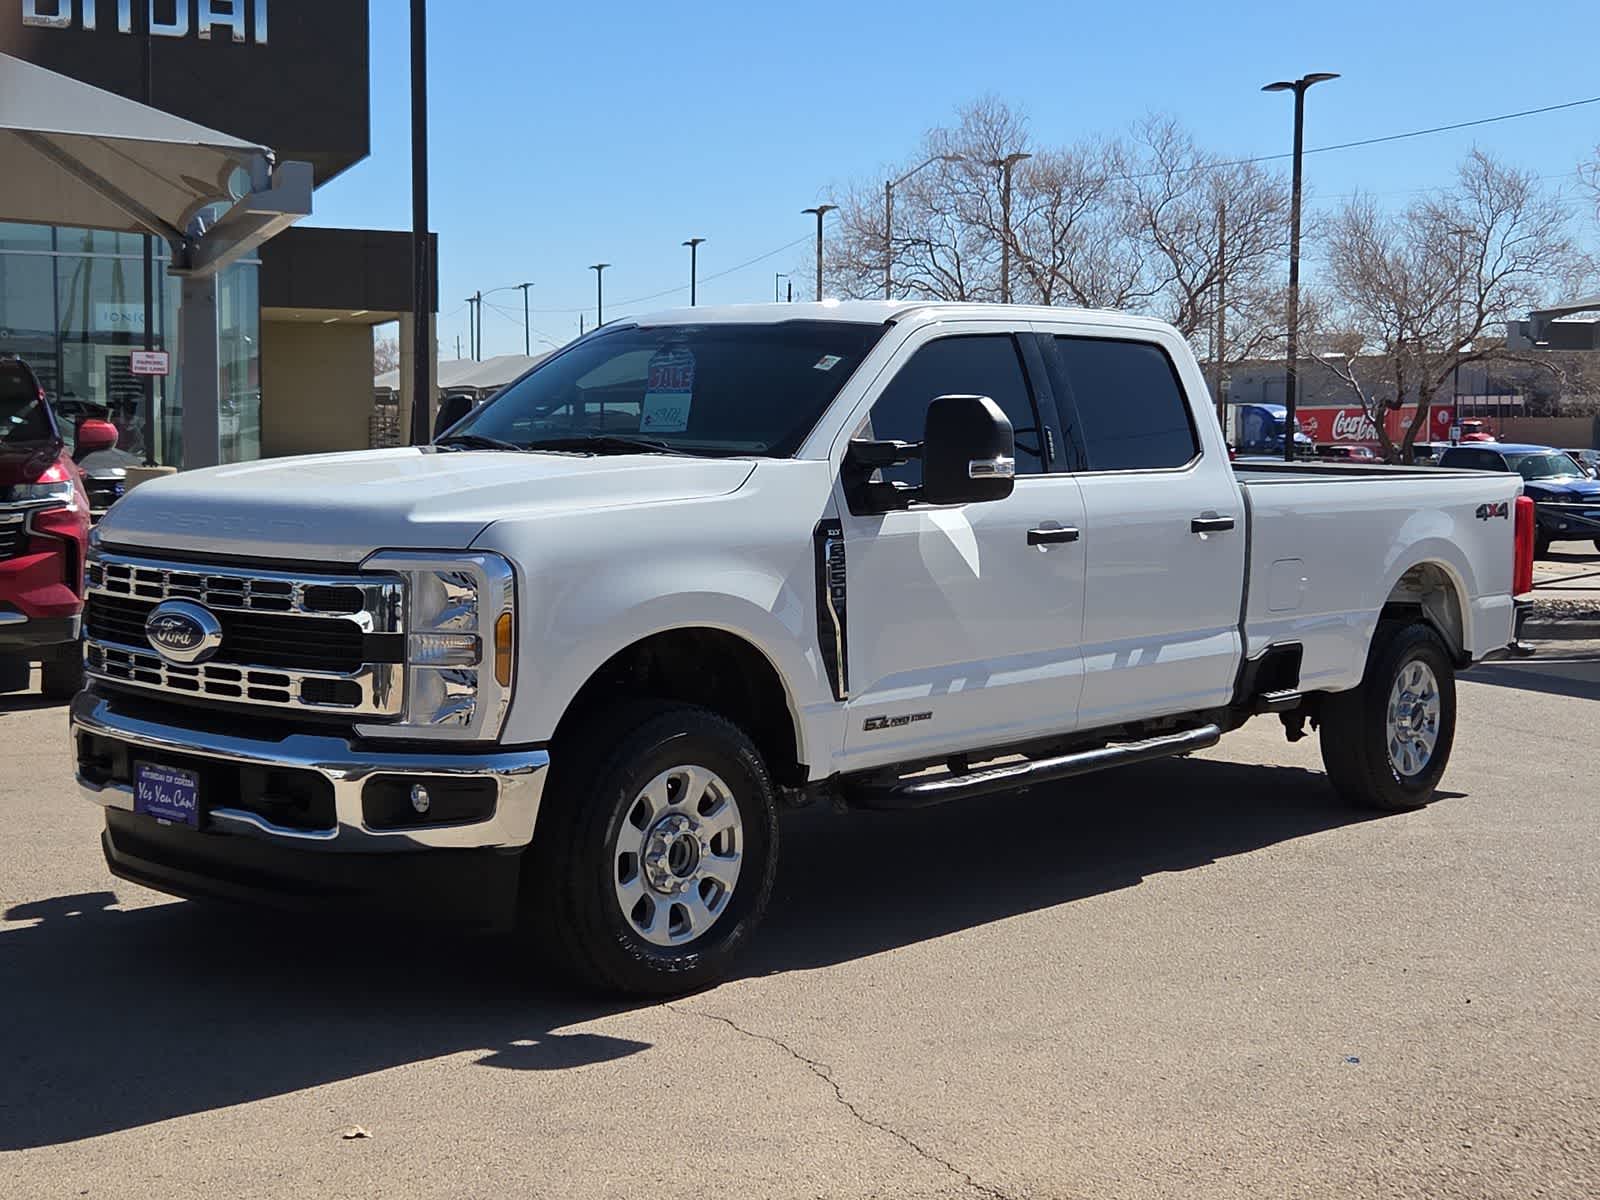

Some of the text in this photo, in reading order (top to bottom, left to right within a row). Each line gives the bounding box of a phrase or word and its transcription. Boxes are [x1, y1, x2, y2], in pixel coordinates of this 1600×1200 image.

[1332, 409, 1388, 441] Coca-Co
[138, 781, 197, 810] Yes You Can!
